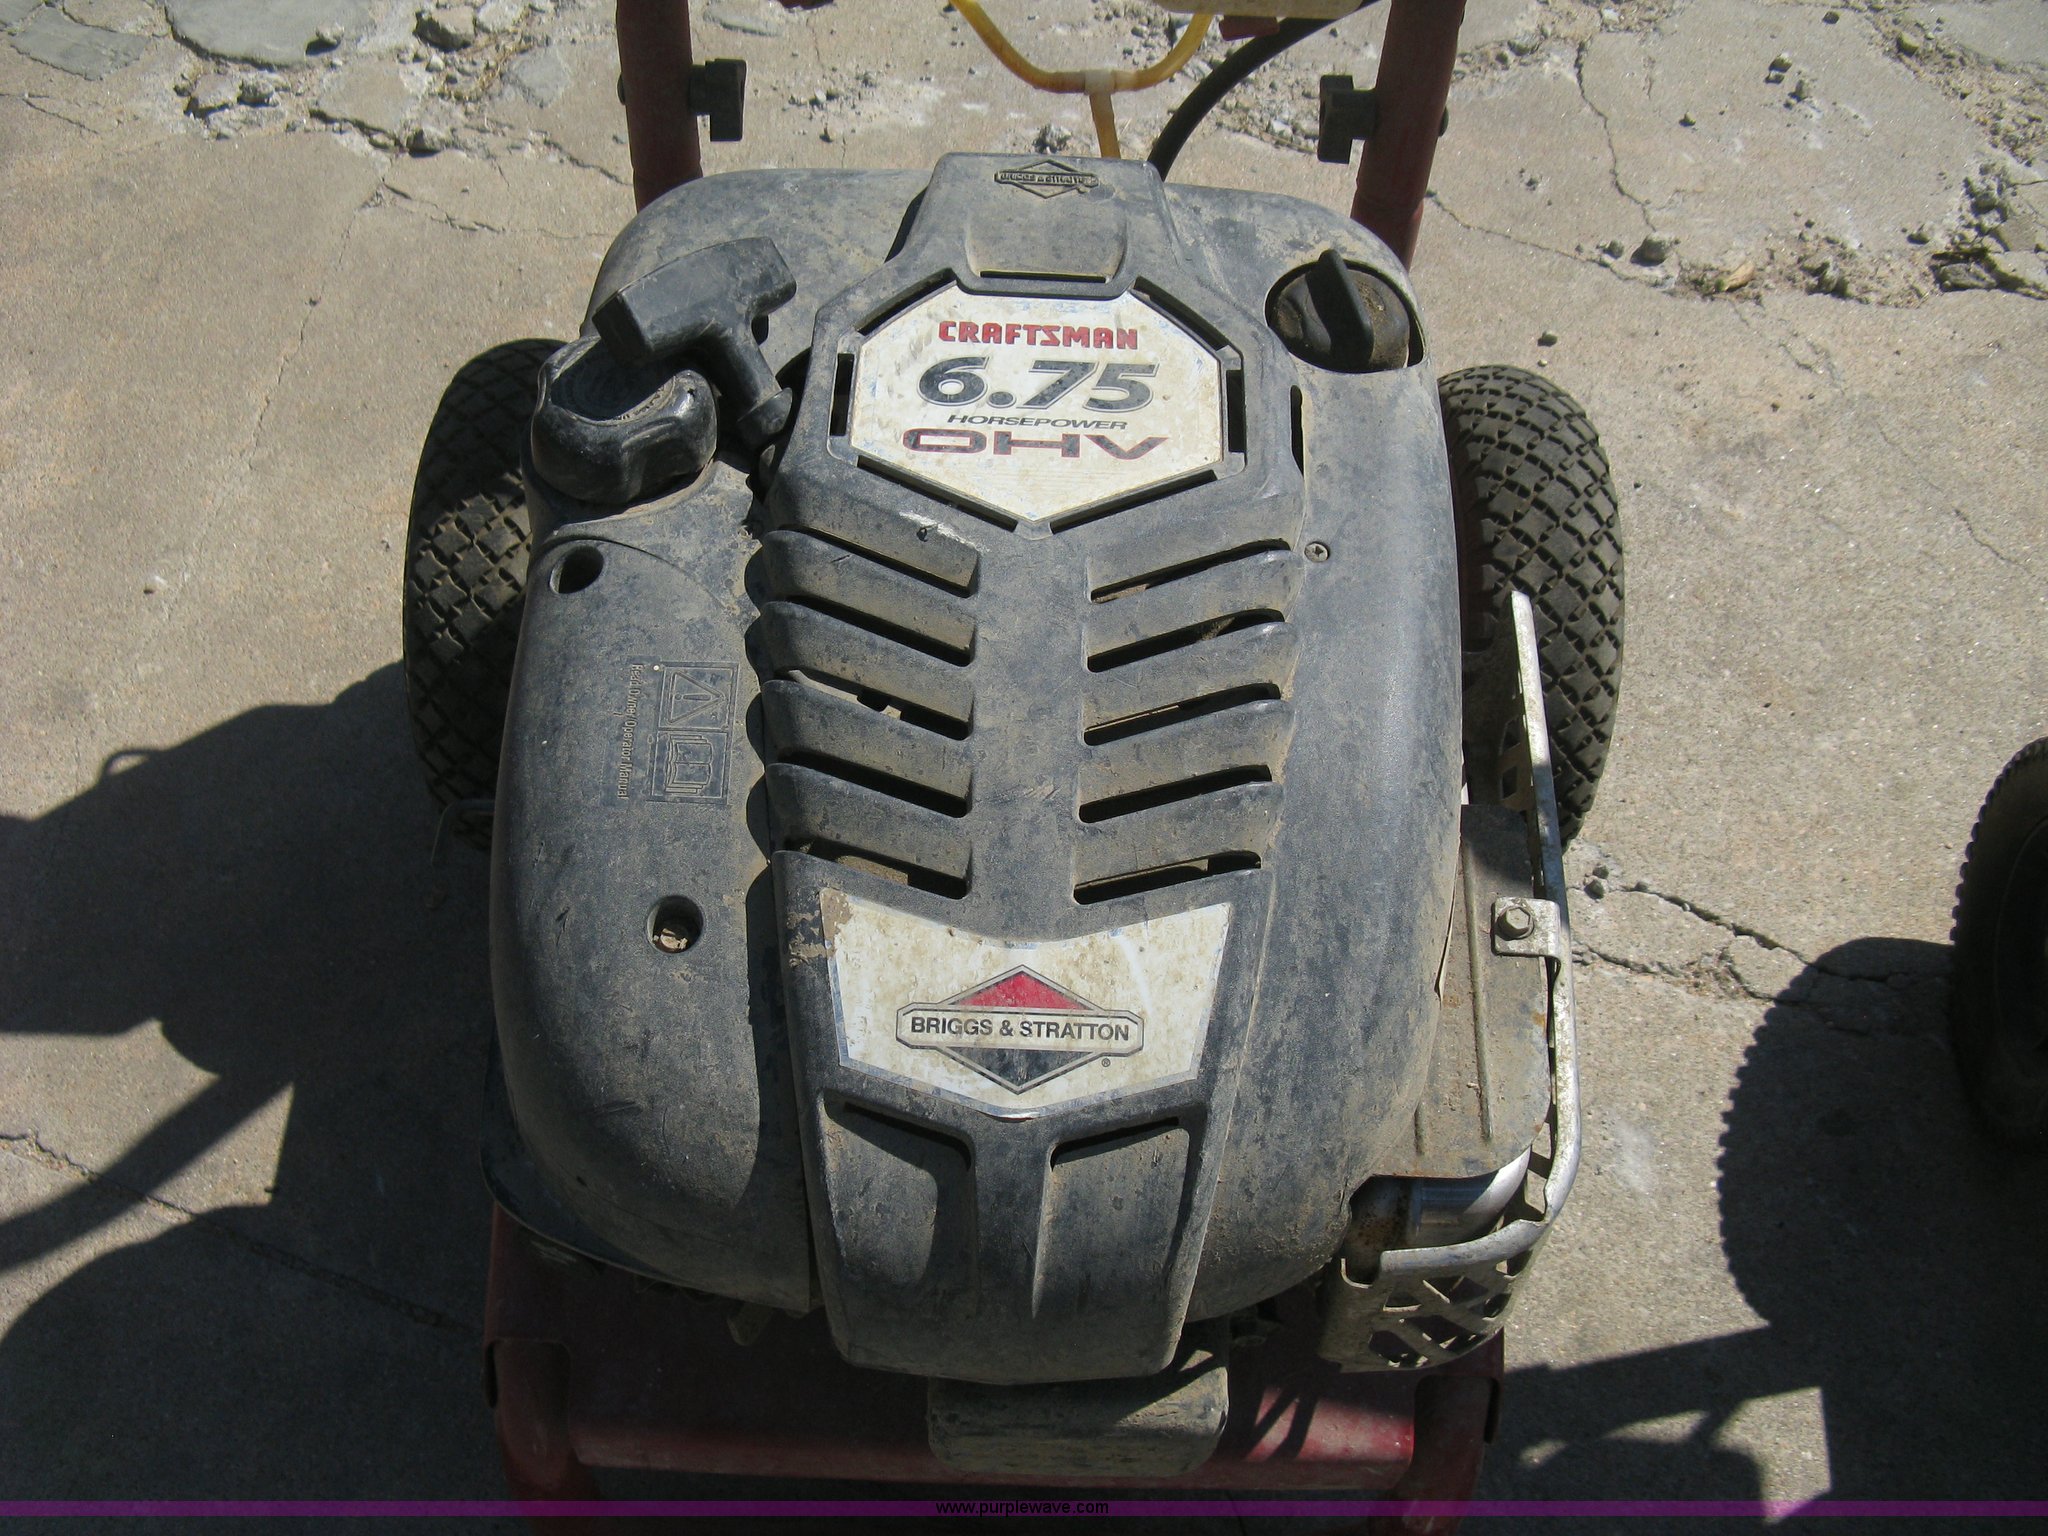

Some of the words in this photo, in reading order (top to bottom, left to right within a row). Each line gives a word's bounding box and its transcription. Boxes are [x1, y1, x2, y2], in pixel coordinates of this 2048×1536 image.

[938, 320, 1138, 350] CRAFTSMAN
[917, 355, 1160, 413] 6.75
[947, 414, 1128, 430] HORSEPOWER
[902, 427, 1169, 460] OHV
[617, 763, 633, 799] Manual
[911, 1016, 993, 1036] BRIGGS
[1000, 1020, 1014, 1037] &
[1019, 1020, 1130, 1041] STRATTON
